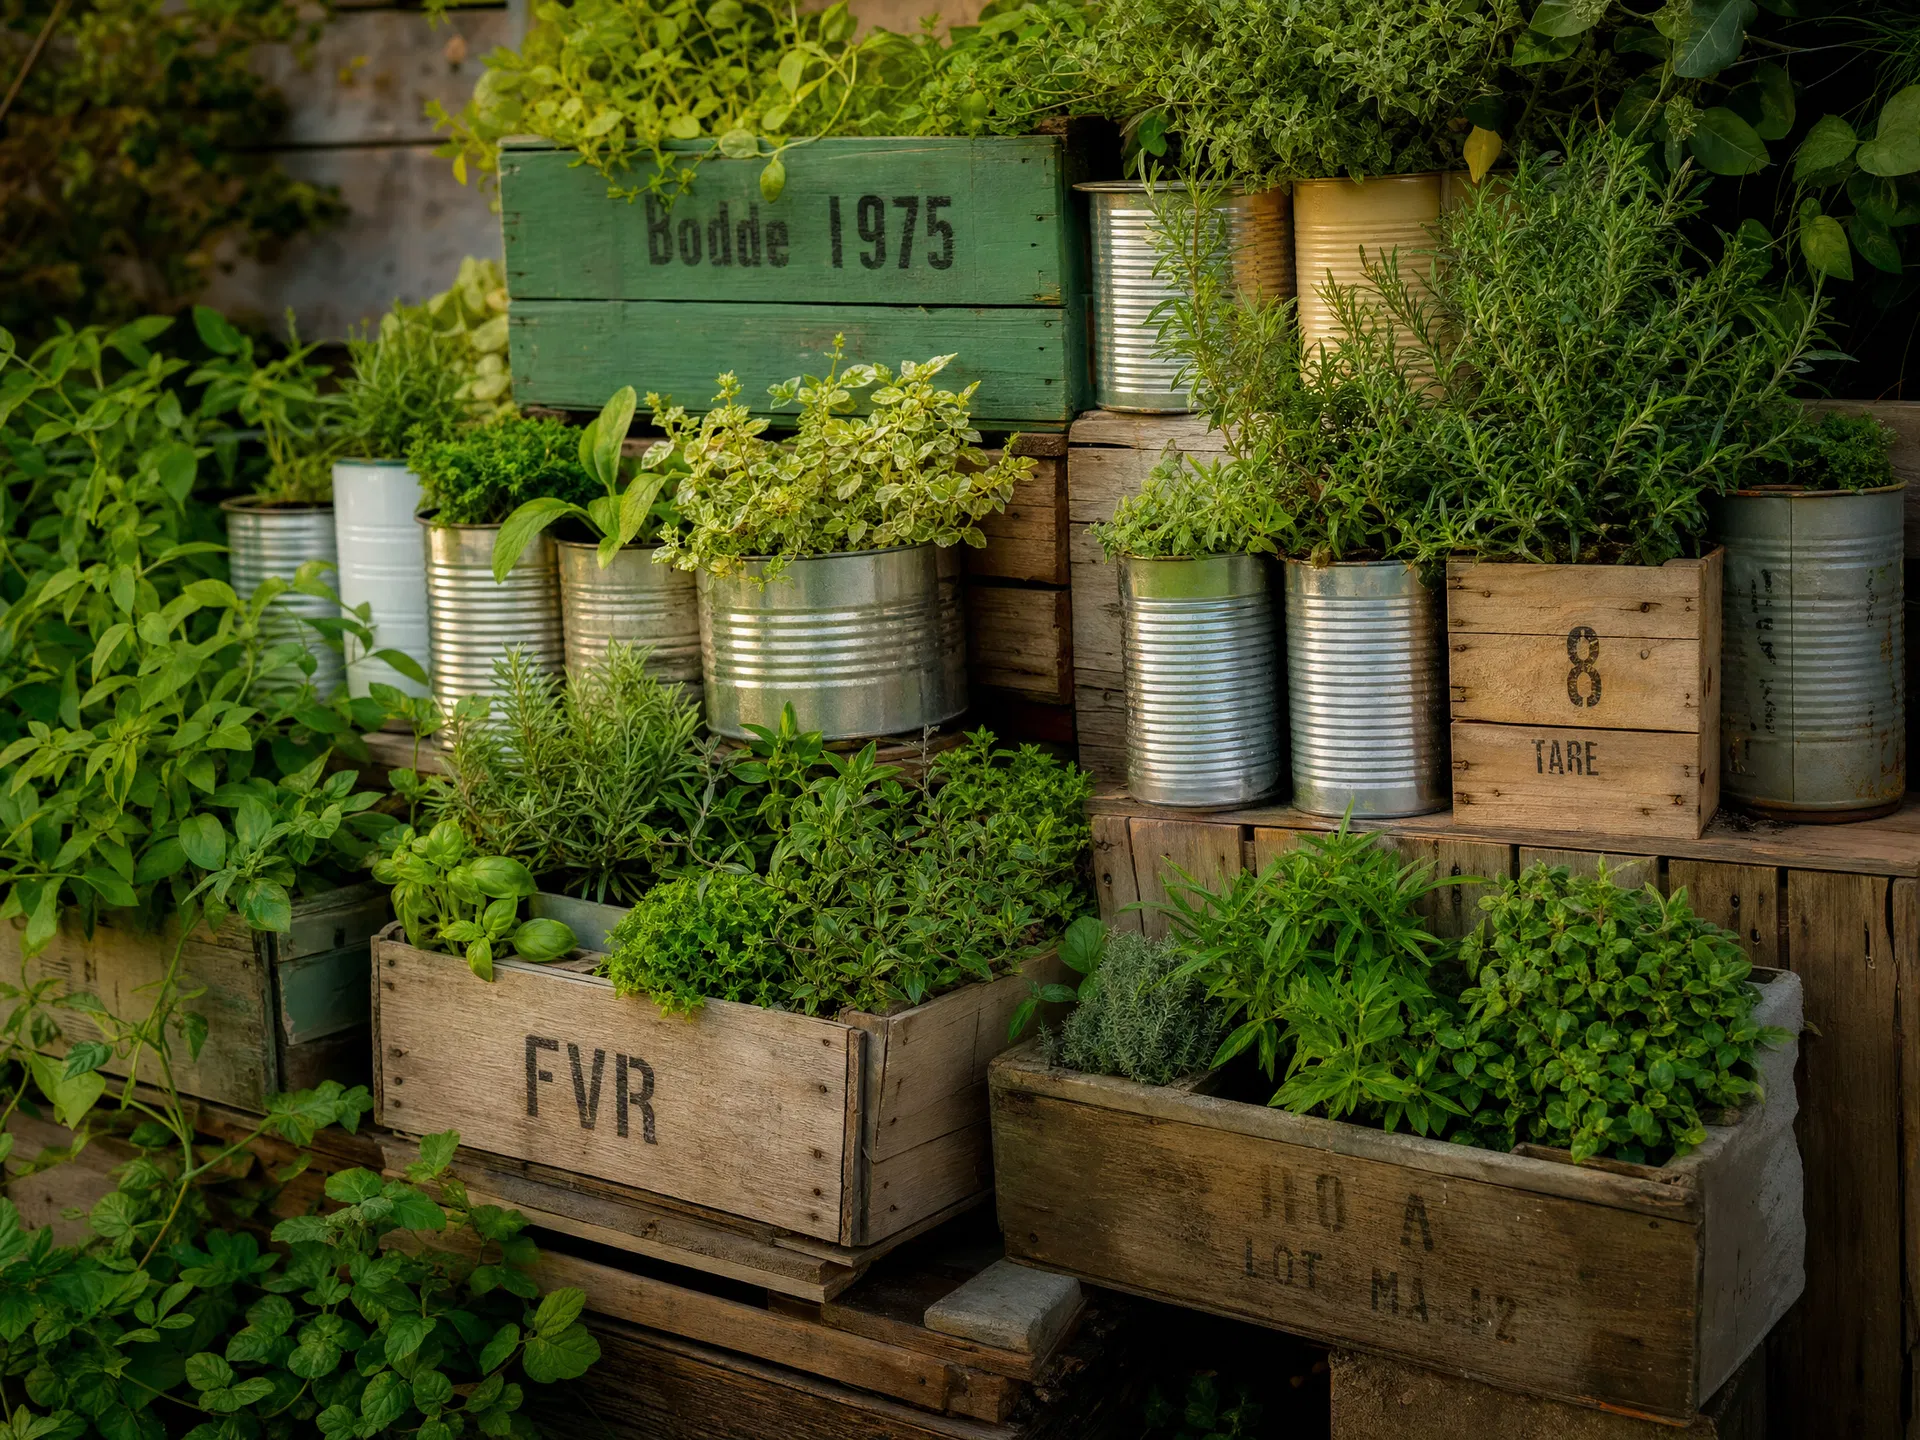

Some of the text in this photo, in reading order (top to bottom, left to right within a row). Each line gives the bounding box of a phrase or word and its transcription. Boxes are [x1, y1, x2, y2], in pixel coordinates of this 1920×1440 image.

[645, 194, 956, 270] Bodde 1975
[1566, 626, 1602, 708] 8
[1531, 739, 1600, 776] TARE
[525, 1034, 658, 1146] FVR
[1245, 1238, 1323, 1289] LOT
